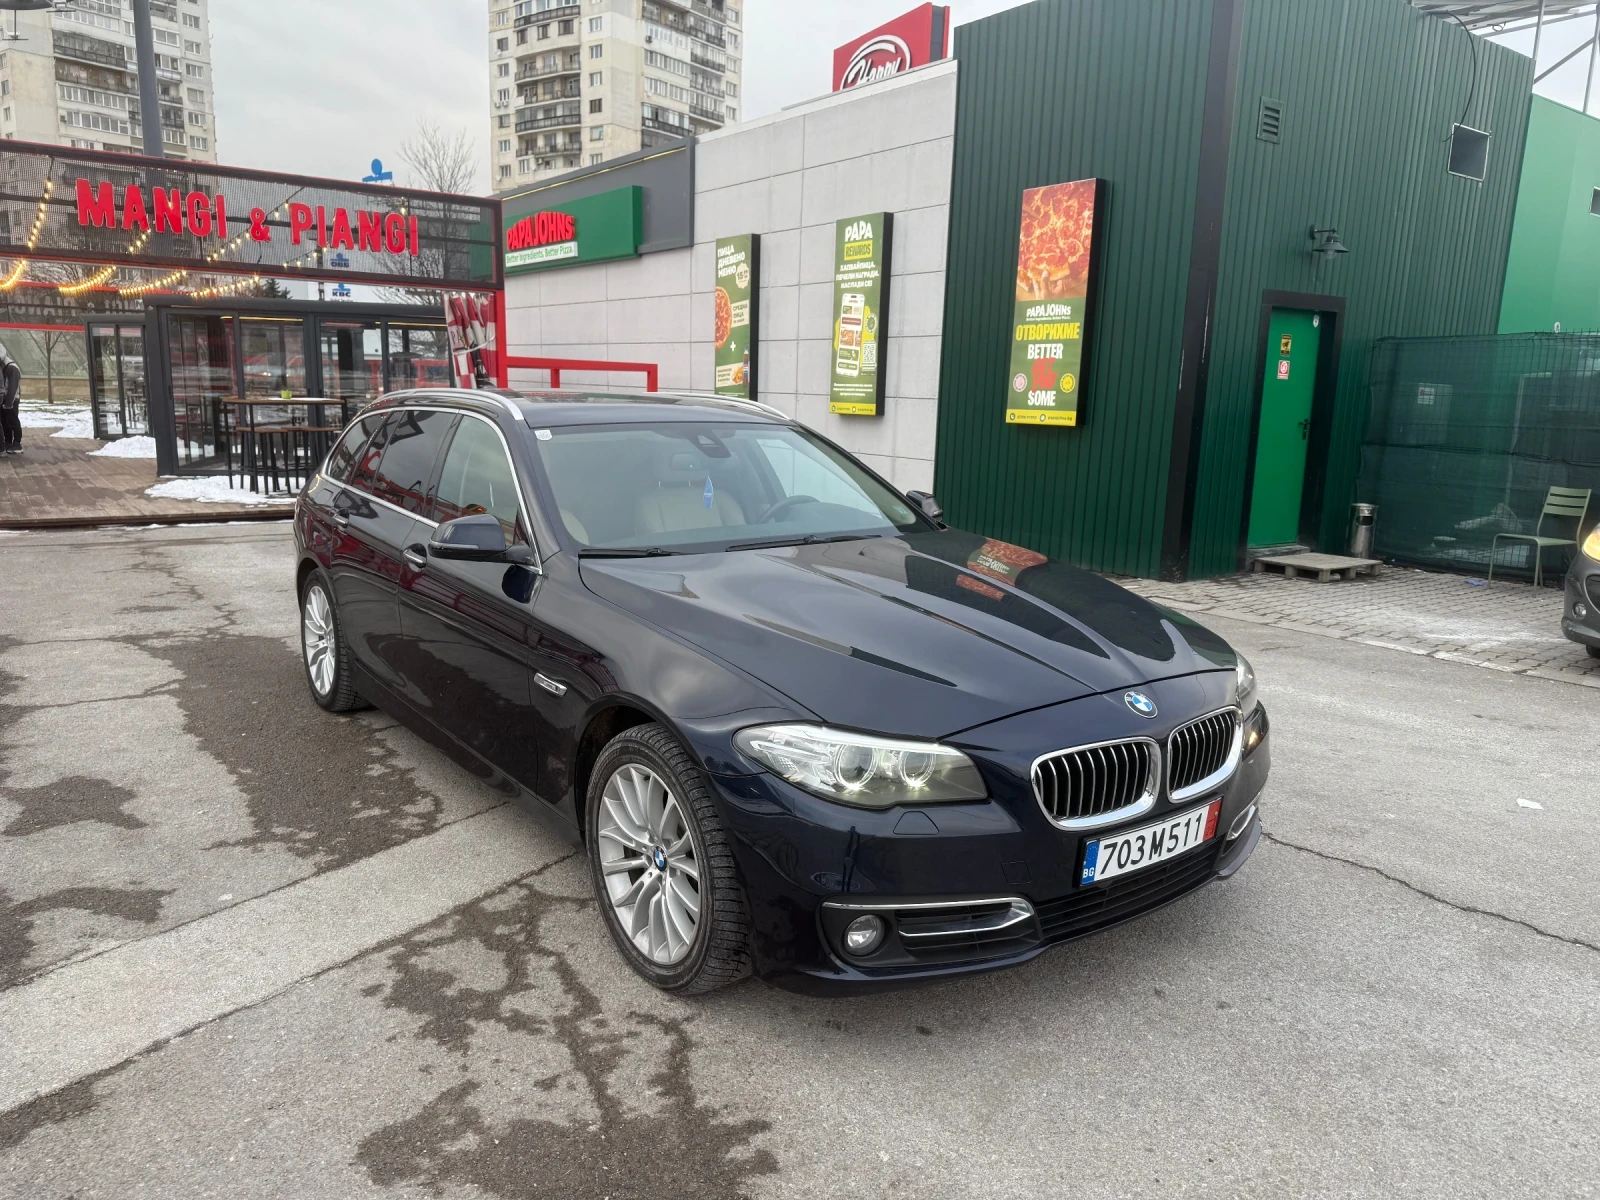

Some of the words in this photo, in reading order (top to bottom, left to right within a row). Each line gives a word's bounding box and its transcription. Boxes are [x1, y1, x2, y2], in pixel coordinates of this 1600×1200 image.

[75, 178, 227, 239] MANGI
[249, 206, 271, 242] &
[289, 201, 419, 256] PIANGI
[845, 221, 872, 242] PAPA
[545, 247, 559, 257] Better
[718, 245, 734, 258] ПИЦА
[718, 265, 736, 278] МЕНЮ
[1016, 323, 1080, 341] ОТВОРИХМЕ
[1027, 343, 1064, 360] BETTER
[1027, 390, 1056, 406] SOME
[1100, 812, 1203, 876] 703M511
[1082, 867, 1095, 879] BG
